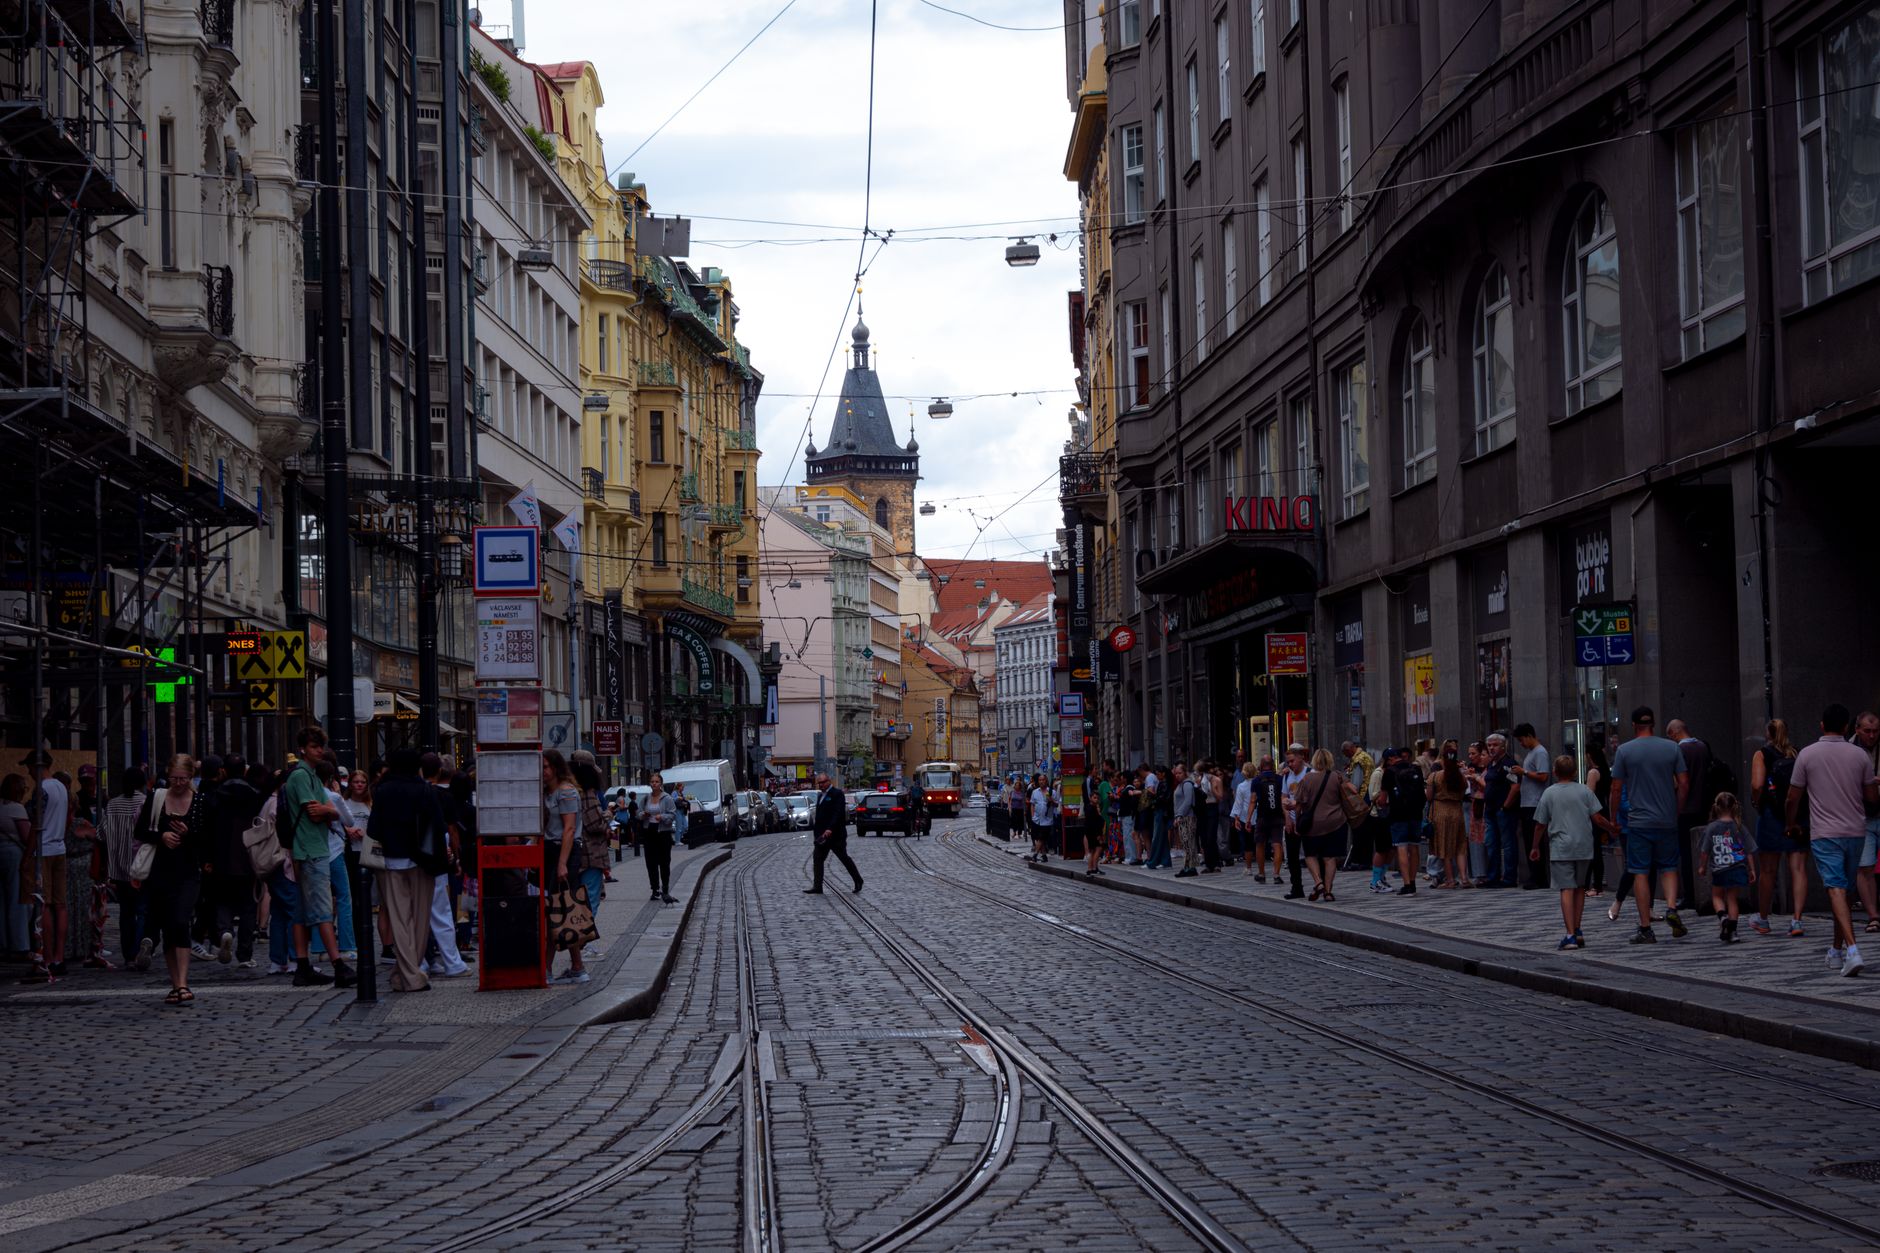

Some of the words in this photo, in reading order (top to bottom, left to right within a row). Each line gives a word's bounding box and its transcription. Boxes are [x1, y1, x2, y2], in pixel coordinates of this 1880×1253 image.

[1225, 495, 1314, 531] KINO
[1575, 531, 1609, 571] bubble
[1607, 621, 1615, 630] A
[1619, 620, 1627, 629] B
[482, 631, 489, 641] 3
[496, 631, 503, 641] 9
[507, 631, 519, 641] 91
[521, 631, 533, 641] 95
[482, 642, 489, 652] 5
[494, 642, 505, 652] 14
[508, 642, 520, 652] 92
[521, 642, 533, 652] 96
[666, 625, 683, 638] TEA
[684, 633, 691, 642] &
[691, 638, 710, 675] COFFEE
[483, 653, 489, 663] 6
[494, 653, 505, 663] 24
[507, 653, 519, 663] 94
[521, 653, 533, 663] 98
[608, 661, 619, 717] HOUSE
[596, 725, 619, 733] NAILS
[1267, 784, 1276, 810] adidas
